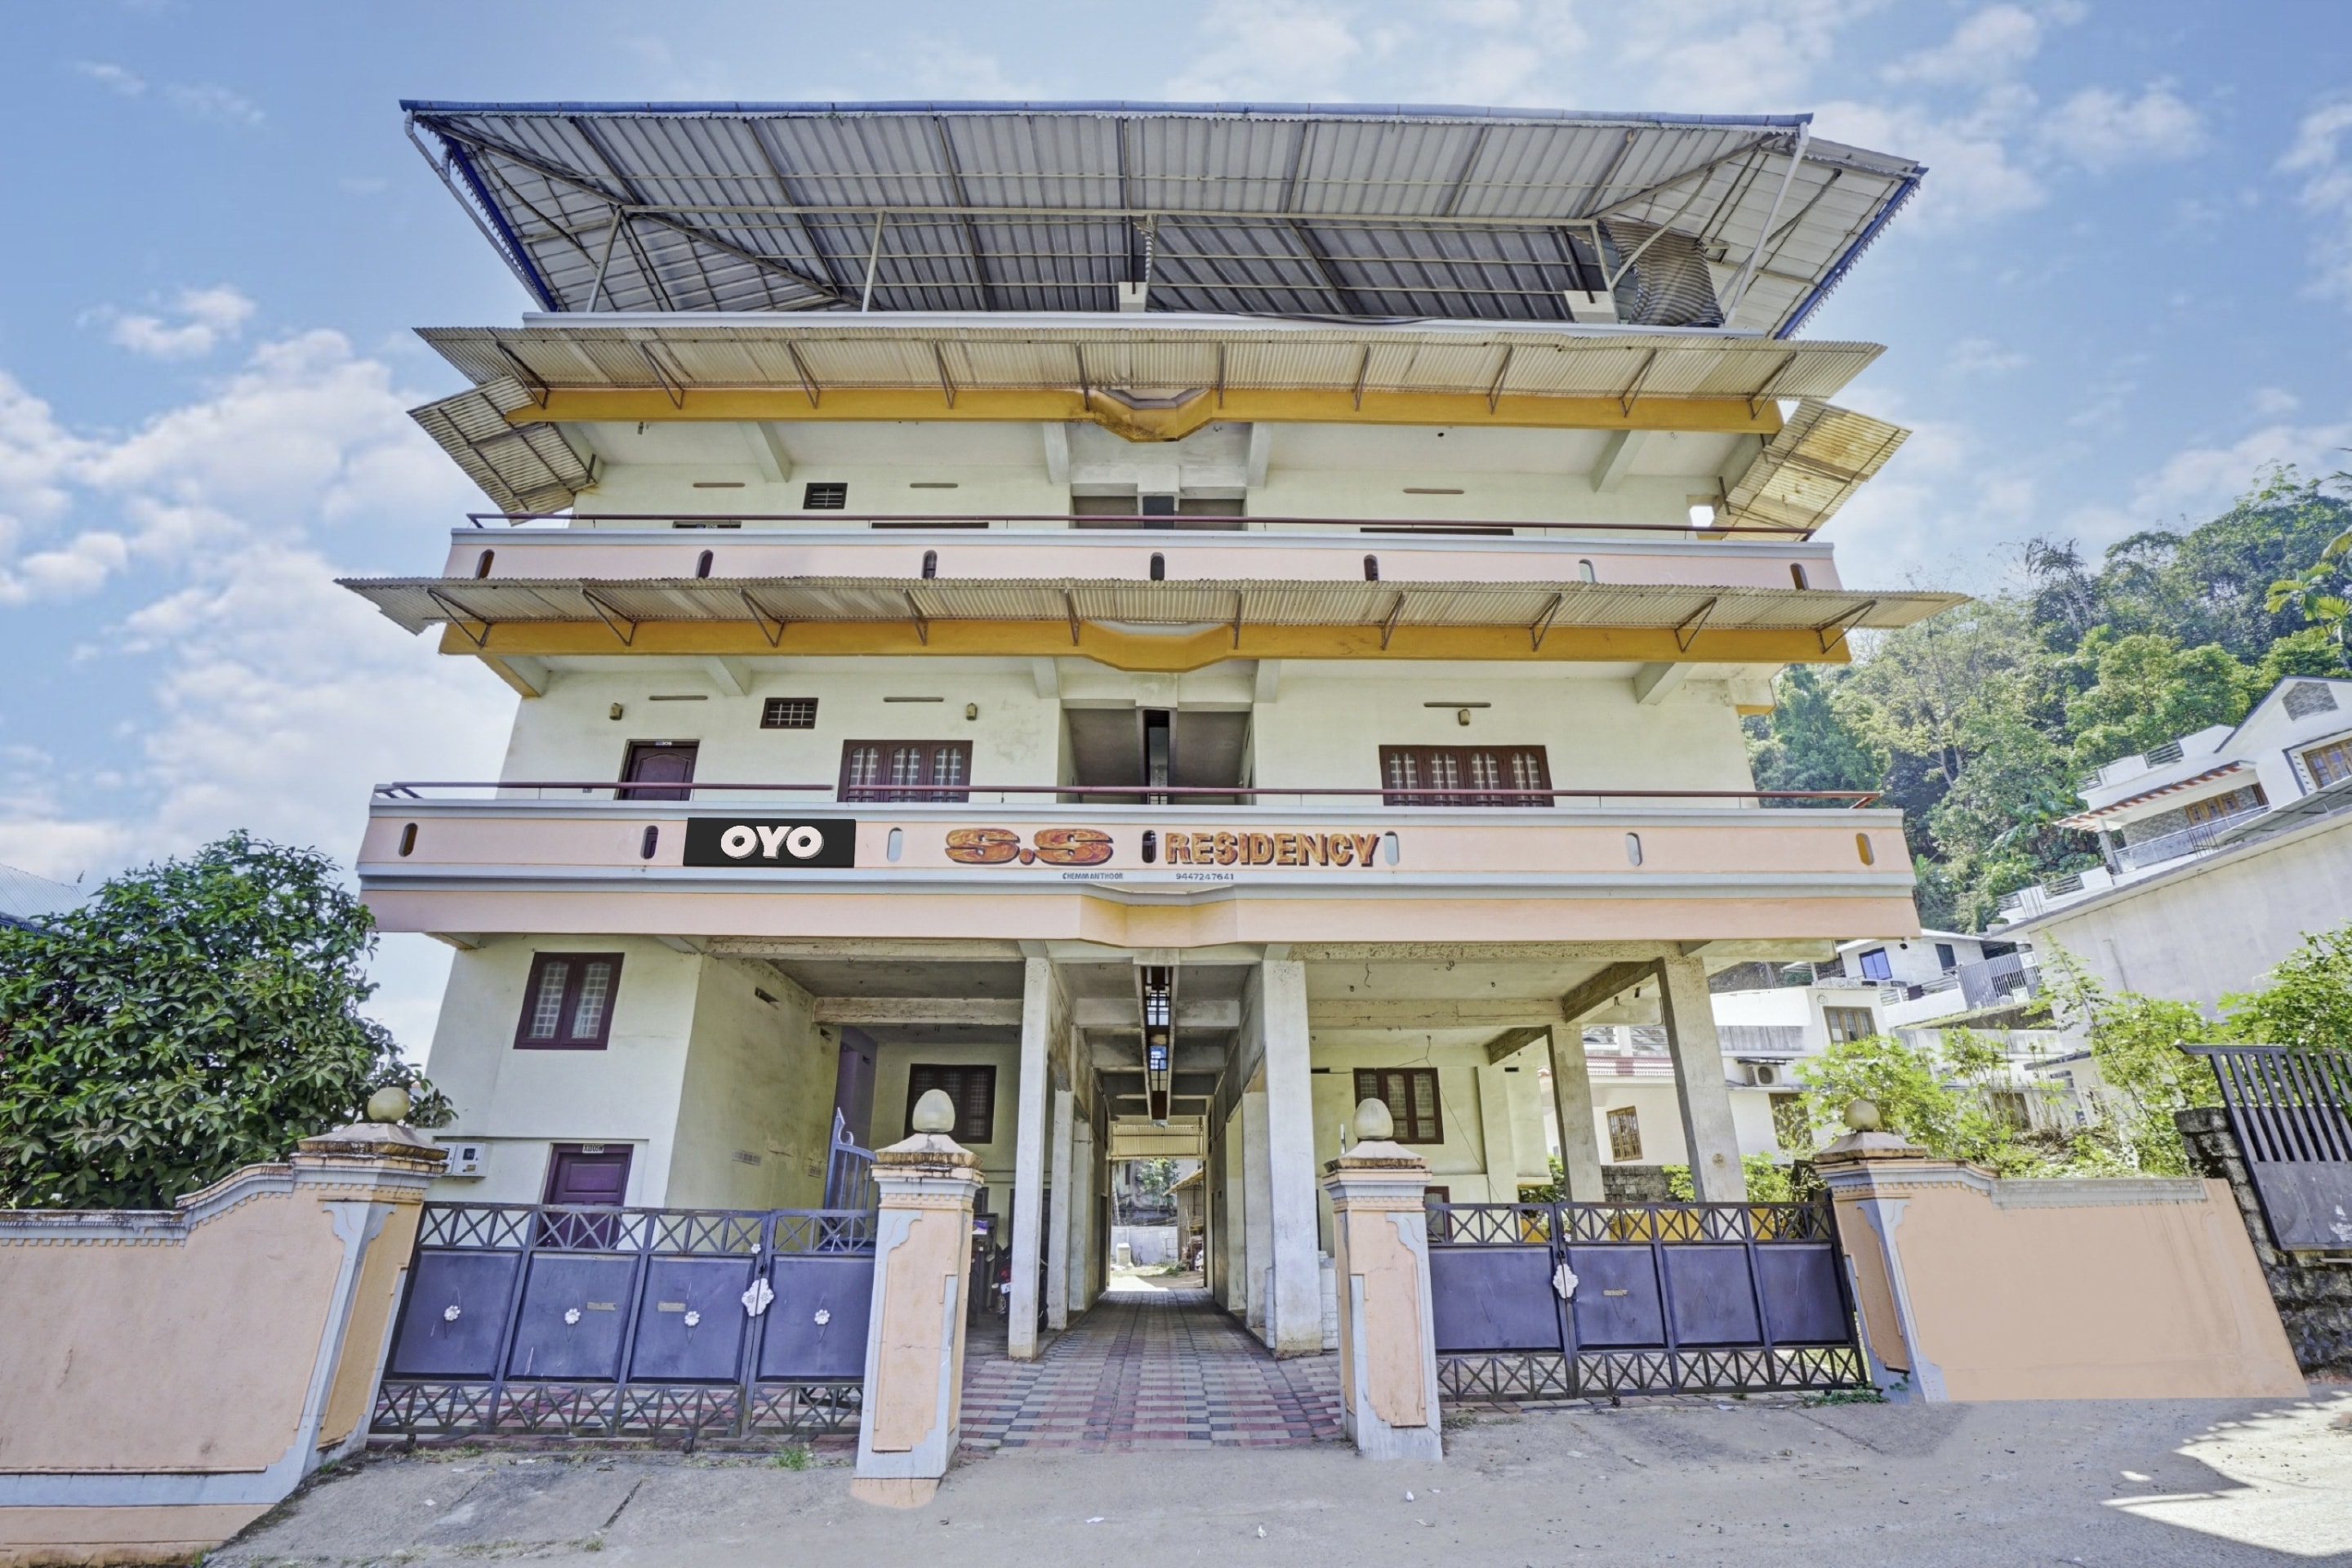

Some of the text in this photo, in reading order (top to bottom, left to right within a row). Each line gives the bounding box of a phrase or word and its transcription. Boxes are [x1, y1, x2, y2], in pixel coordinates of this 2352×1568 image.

[720, 825, 824, 859] OYO
[945, 827, 1380, 867] S.S RESIDENCY
